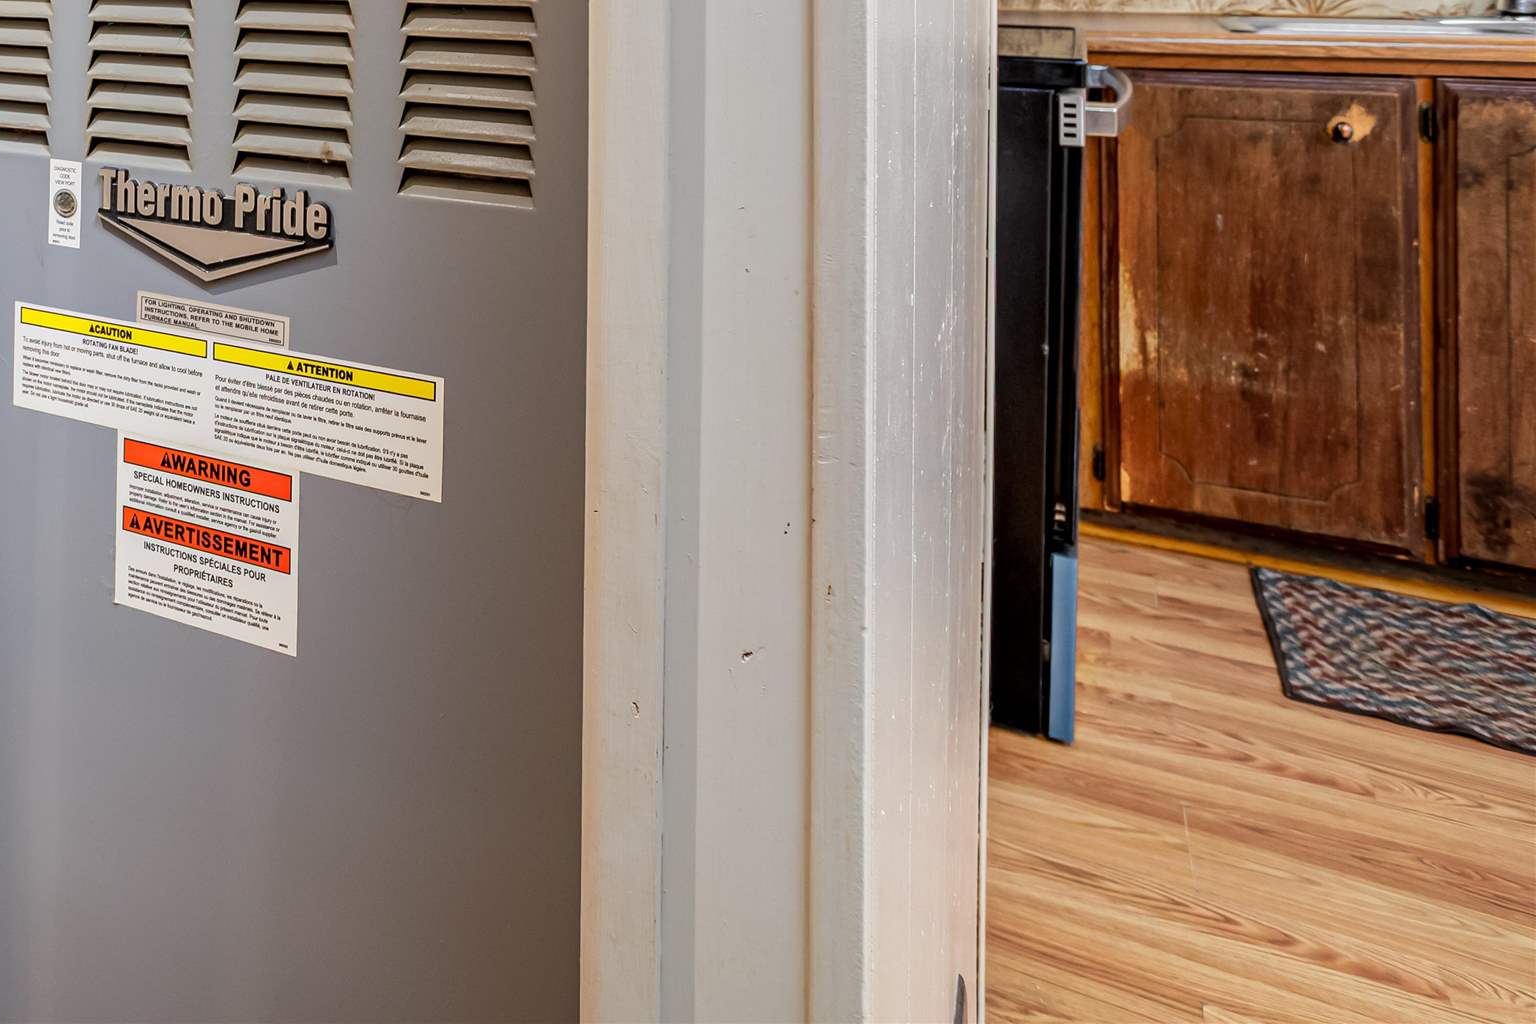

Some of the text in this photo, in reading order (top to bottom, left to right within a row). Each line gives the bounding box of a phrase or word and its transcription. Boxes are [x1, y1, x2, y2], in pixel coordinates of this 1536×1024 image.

[99, 166, 332, 240] Thermo Pride
[144, 298, 157, 306] FOR
[188, 306, 223, 318] OPERATING
[224, 311, 238, 321] AND
[238, 314, 276, 327] SHUTDOWN
[144, 314, 172, 325] FURNACE
[190, 314, 210, 323] REFER
[221, 320, 233, 328] THE
[235, 323, 259, 332] MOBILE
[260, 328, 279, 336] HOME
[95, 325, 132, 339] CAUTION
[82, 338, 139, 355] ROTATING FAN BLADE!
[296, 363, 353, 381] ATTENTION
[265, 373, 375, 400] PALE DE VENTILATEUR EN ROTATION!
[170, 455, 251, 486] WARNING
[134, 471, 280, 513] SPECIAL HOMEOWNERS INSTRUCTIONS
[143, 516, 283, 566] AVERTISSEMENT
[144, 542, 266, 582] INSTRUCTIONS SPÉCIALES POUR
[173, 564, 233, 587] PROPRIÉTAIRES
